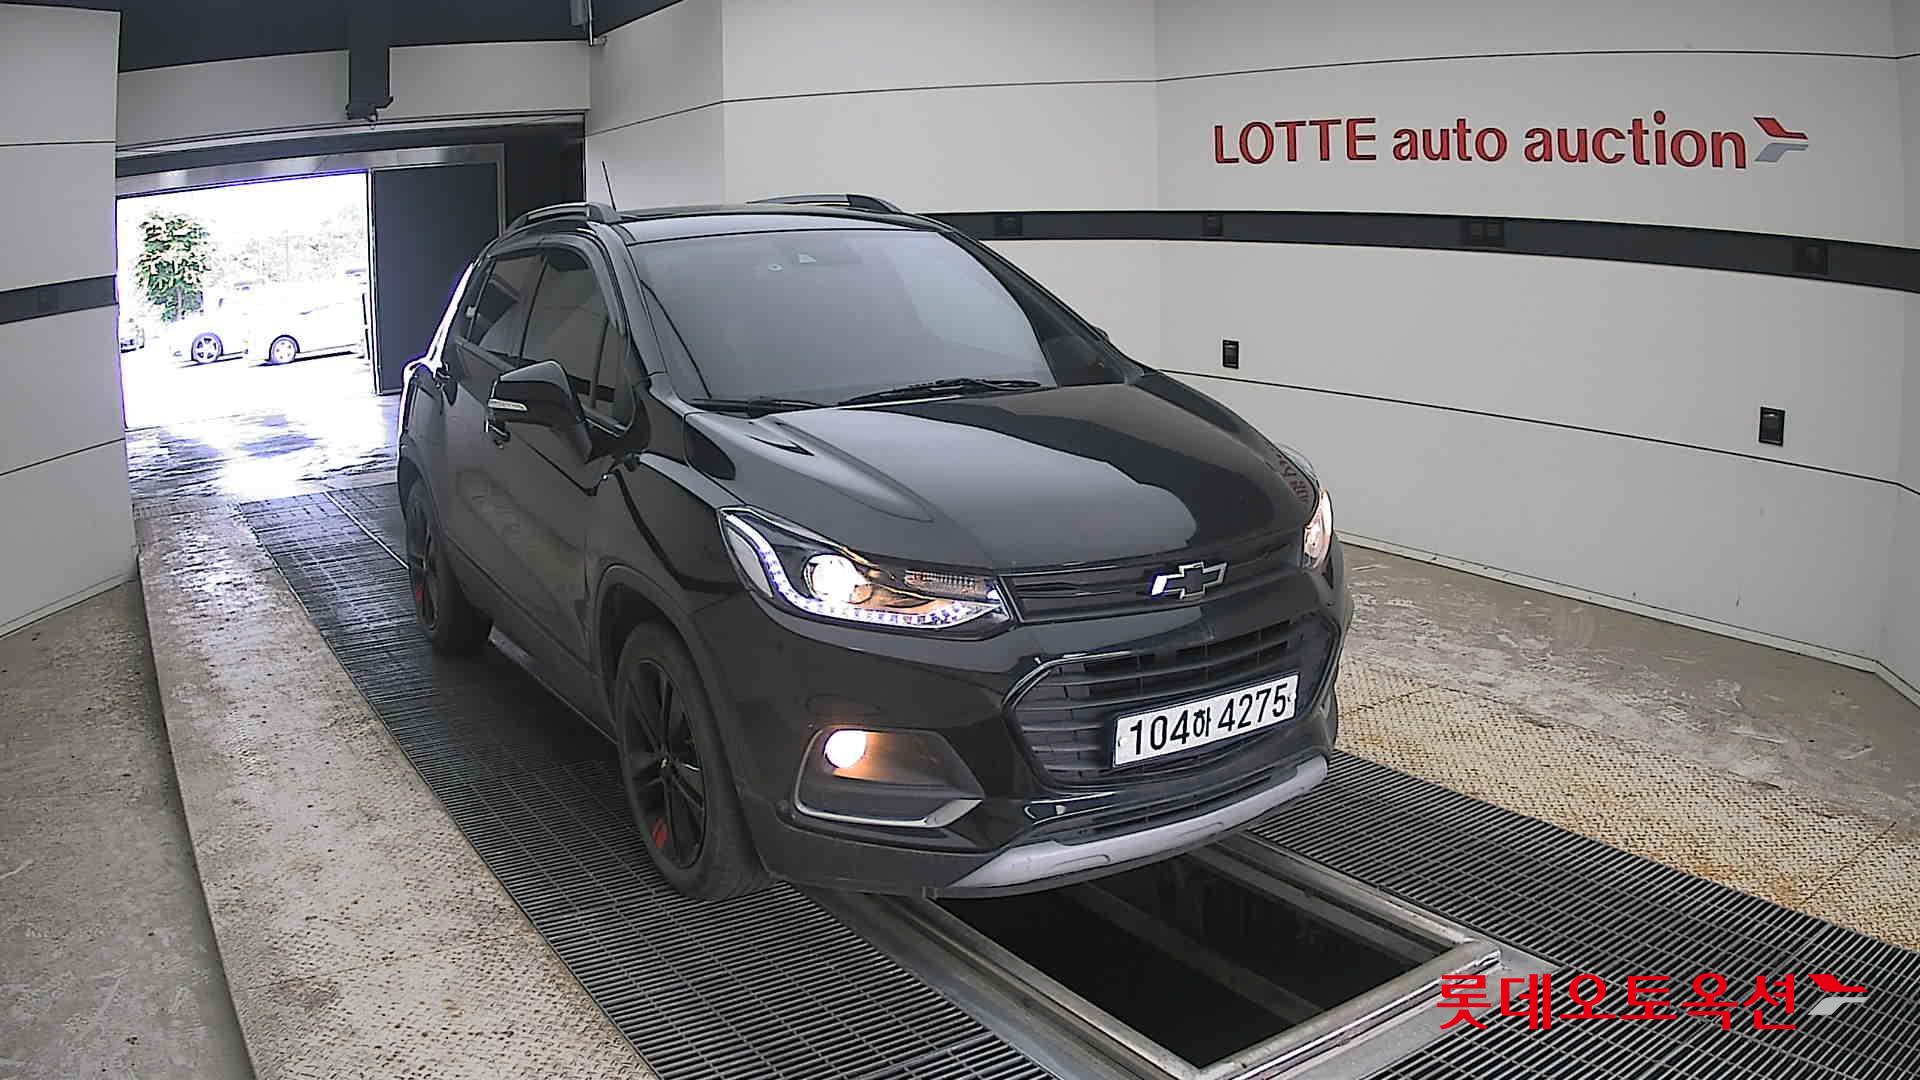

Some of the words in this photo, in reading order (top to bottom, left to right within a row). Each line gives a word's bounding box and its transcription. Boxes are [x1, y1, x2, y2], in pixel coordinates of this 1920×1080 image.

[1214, 118, 1377, 164] LOTTE
[1392, 117, 1510, 161] auto
[1523, 111, 1746, 168] auction
[1130, 707, 1212, 755] 104하
[1217, 682, 1289, 732] 4275
